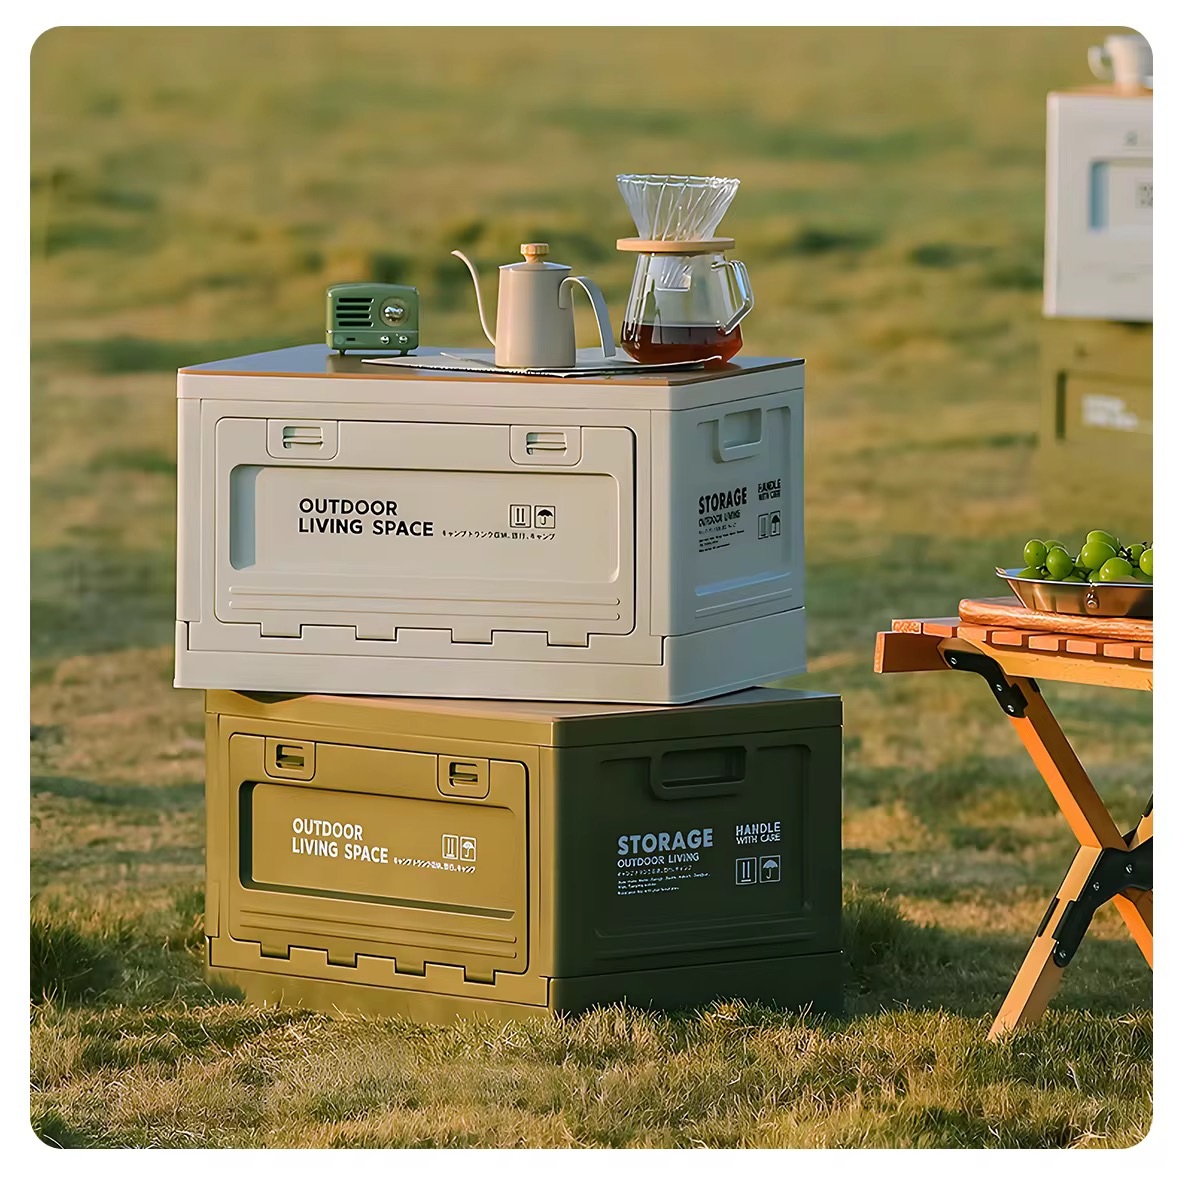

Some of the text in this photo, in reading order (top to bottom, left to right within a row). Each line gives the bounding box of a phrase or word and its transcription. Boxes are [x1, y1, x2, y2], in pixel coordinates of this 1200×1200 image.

[299, 497, 398, 516] OUTDOOR
[698, 486, 747, 515] STORAGE
[298, 517, 434, 537] LIVING SPACE
[292, 817, 364, 842] OUTDOOR
[735, 821, 781, 837] HANDLE
[292, 836, 389, 864] LIVING SPACE
[617, 828, 714, 856] STORAGE
[736, 835, 758, 845] WITH
[617, 852, 700, 869] OUTDOOR LIVING
